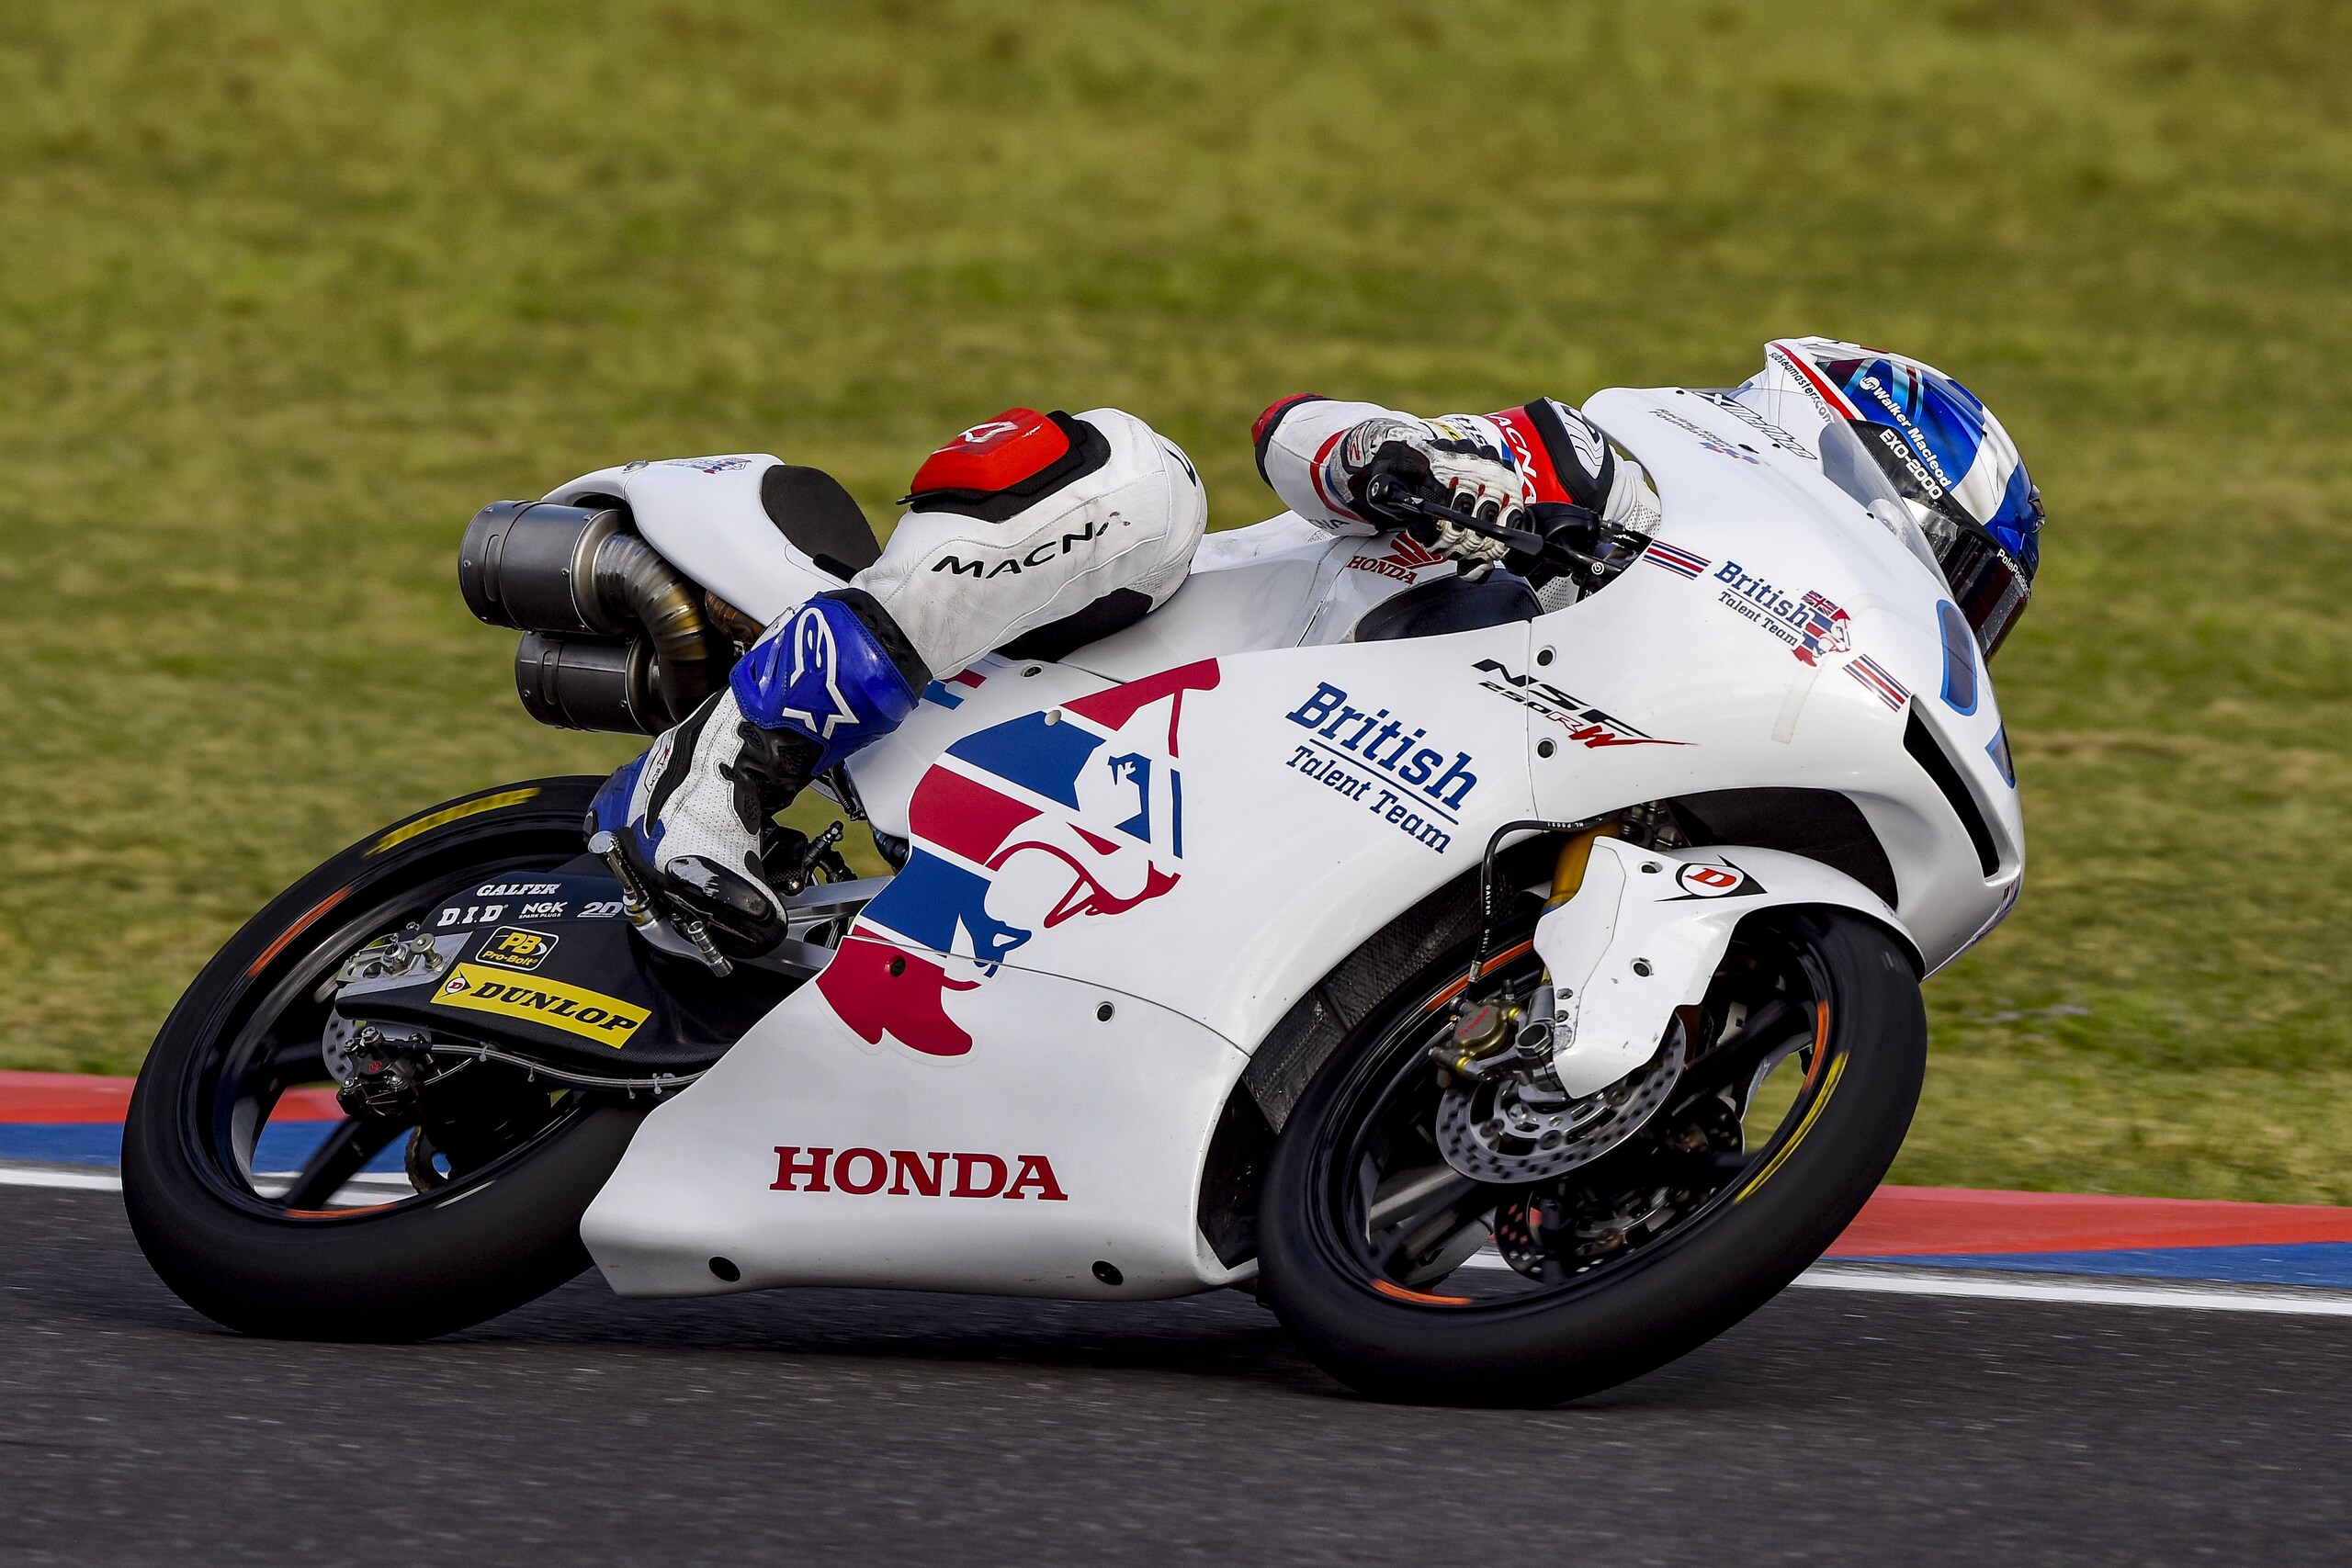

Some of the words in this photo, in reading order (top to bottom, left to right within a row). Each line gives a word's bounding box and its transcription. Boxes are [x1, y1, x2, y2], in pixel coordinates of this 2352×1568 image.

[1769, 352, 1836, 425] subseamaster.com
[1873, 388, 1912, 428] Walker
[1907, 426, 1952, 488] Macleod
[1879, 428, 1943, 500] EXO-2000
[1346, 556, 1418, 585] HONDA
[1713, 560, 1810, 629] British
[1718, 591, 1762, 623] Talent
[1760, 617, 1799, 647] Team
[1285, 681, 1478, 812] British
[1286, 745, 1372, 802] Talent
[1369, 789, 1452, 854] Team
[476, 883, 561, 897] GALFER
[1685, 867, 1737, 888] D
[436, 904, 503, 928] D.I.D
[521, 901, 569, 915] NGK
[577, 901, 624, 918] 2D
[497, 931, 543, 954] PB
[447, 981, 463, 990] D
[469, 981, 639, 1032] DUNLOP
[769, 1145, 1069, 1201] HONDA
